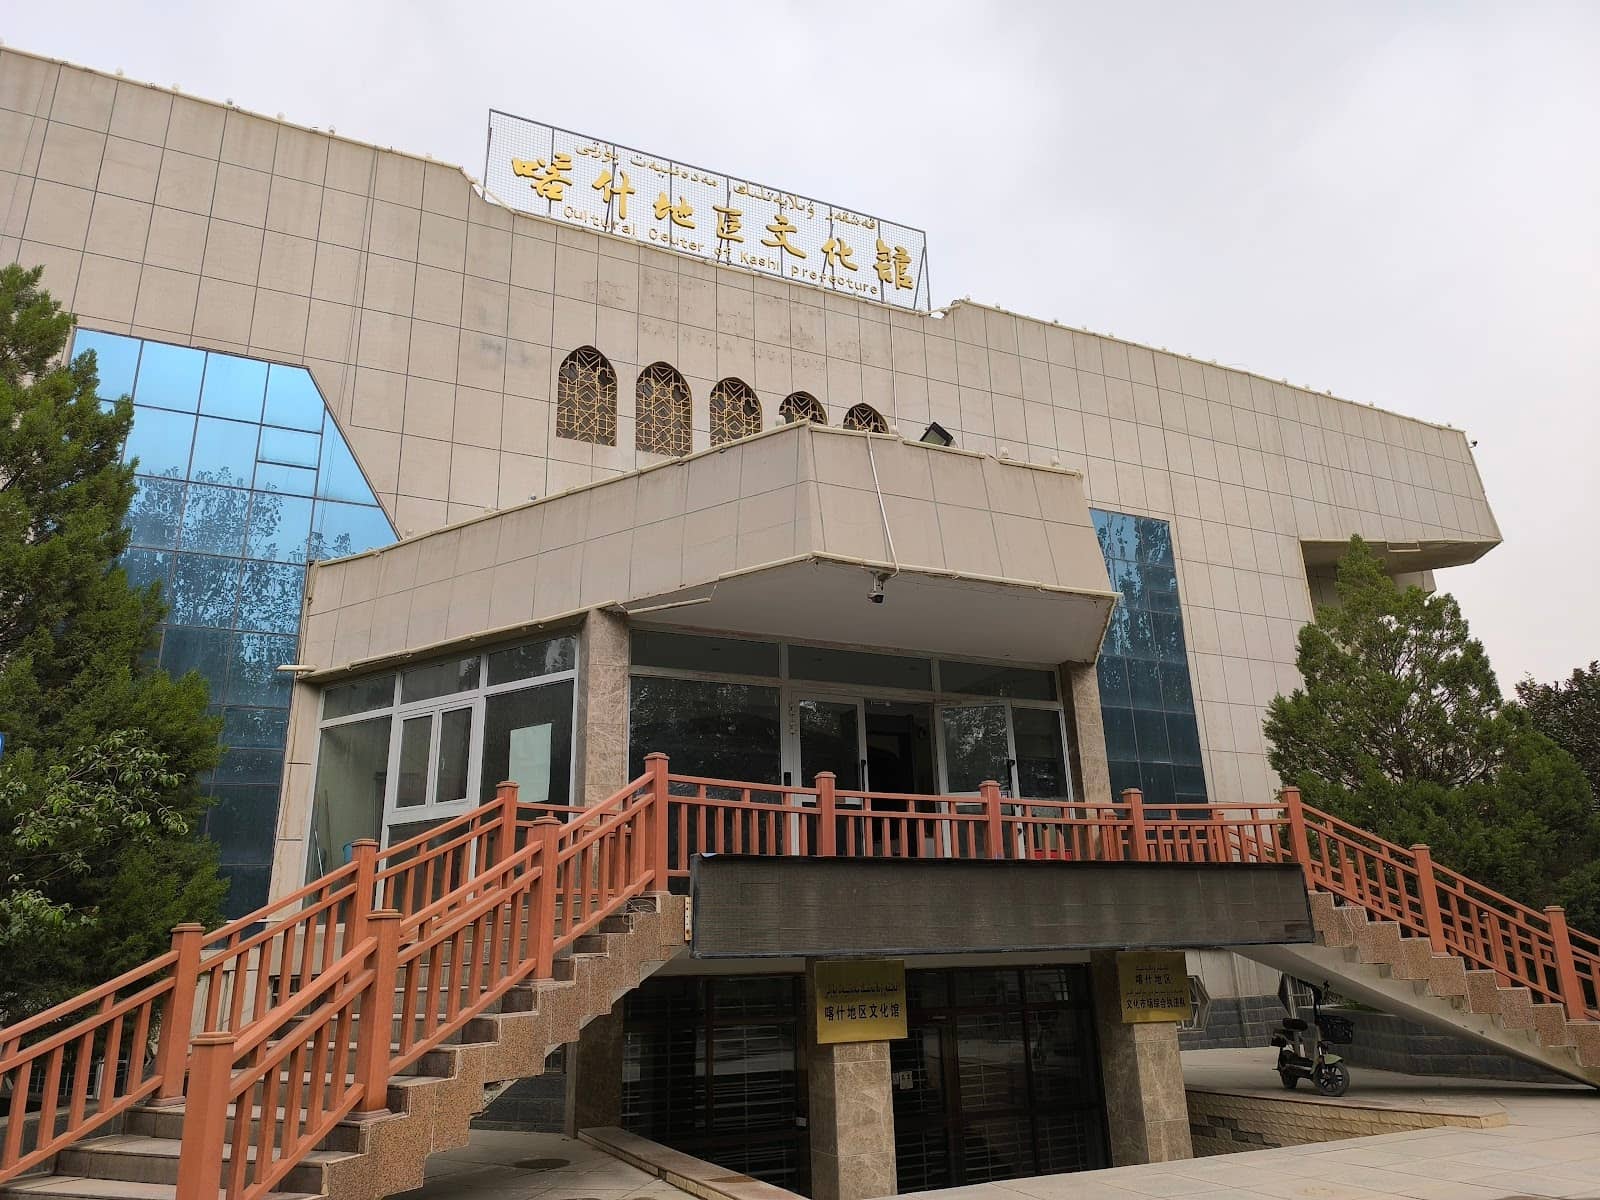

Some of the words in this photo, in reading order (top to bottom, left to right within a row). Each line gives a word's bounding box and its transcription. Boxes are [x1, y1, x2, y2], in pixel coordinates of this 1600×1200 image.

[714, 246, 732, 259] of
[825, 1004, 900, 1021] 喀什地区文化馆
